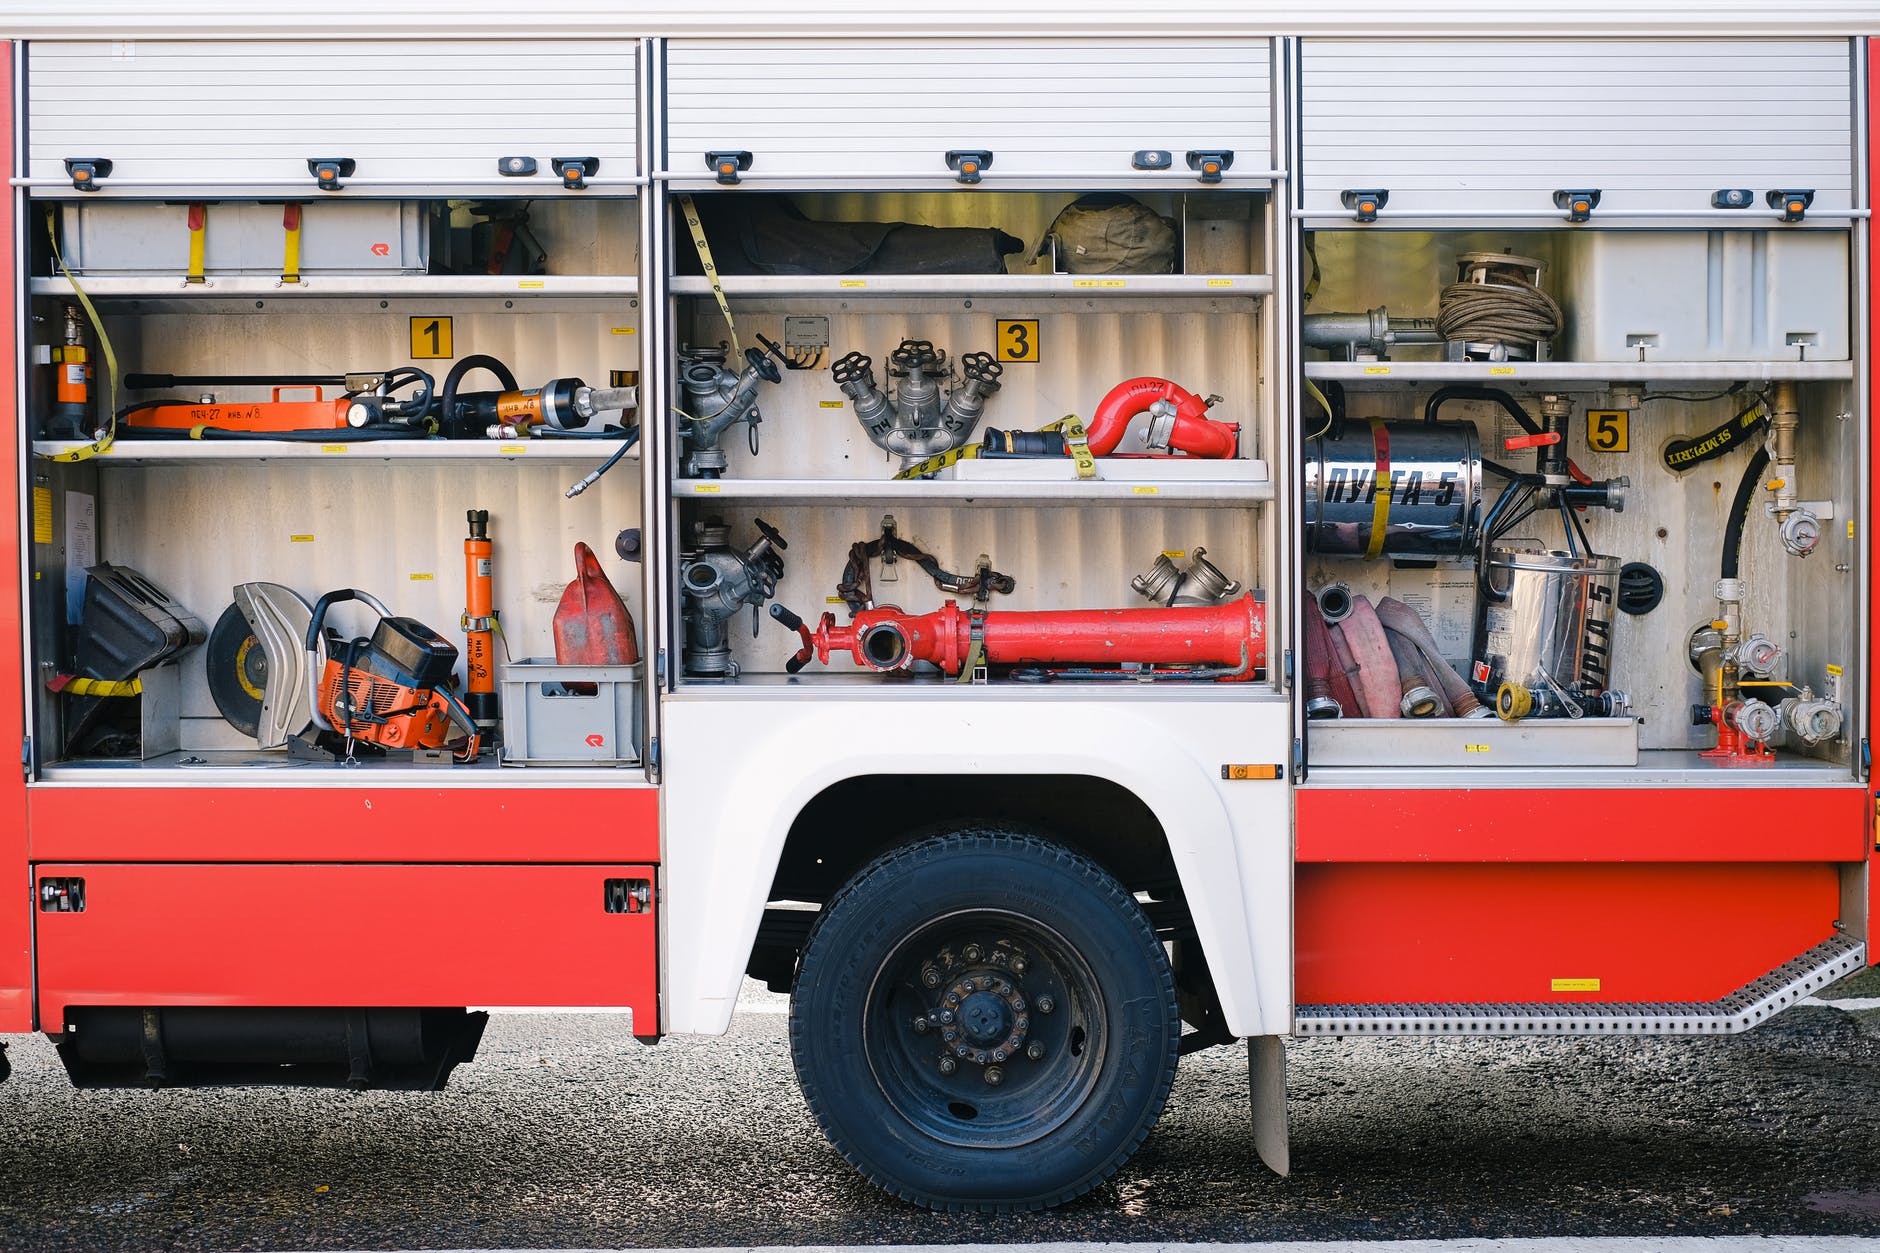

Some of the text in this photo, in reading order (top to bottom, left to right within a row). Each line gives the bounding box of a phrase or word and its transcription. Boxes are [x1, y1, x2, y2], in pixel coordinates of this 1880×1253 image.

[423, 320, 440, 355] 1
[1007, 324, 1030, 359] 3
[1149, 381, 1165, 393] 27
[945, 414, 964, 433] 27
[1597, 415, 1619, 449] 5
[1667, 428, 1732, 465] SEMPERIT
[1324, 467, 1423, 506] ПУГА
[1435, 471, 1458, 507] 5
[1580, 582, 1612, 691] УРГА 5
